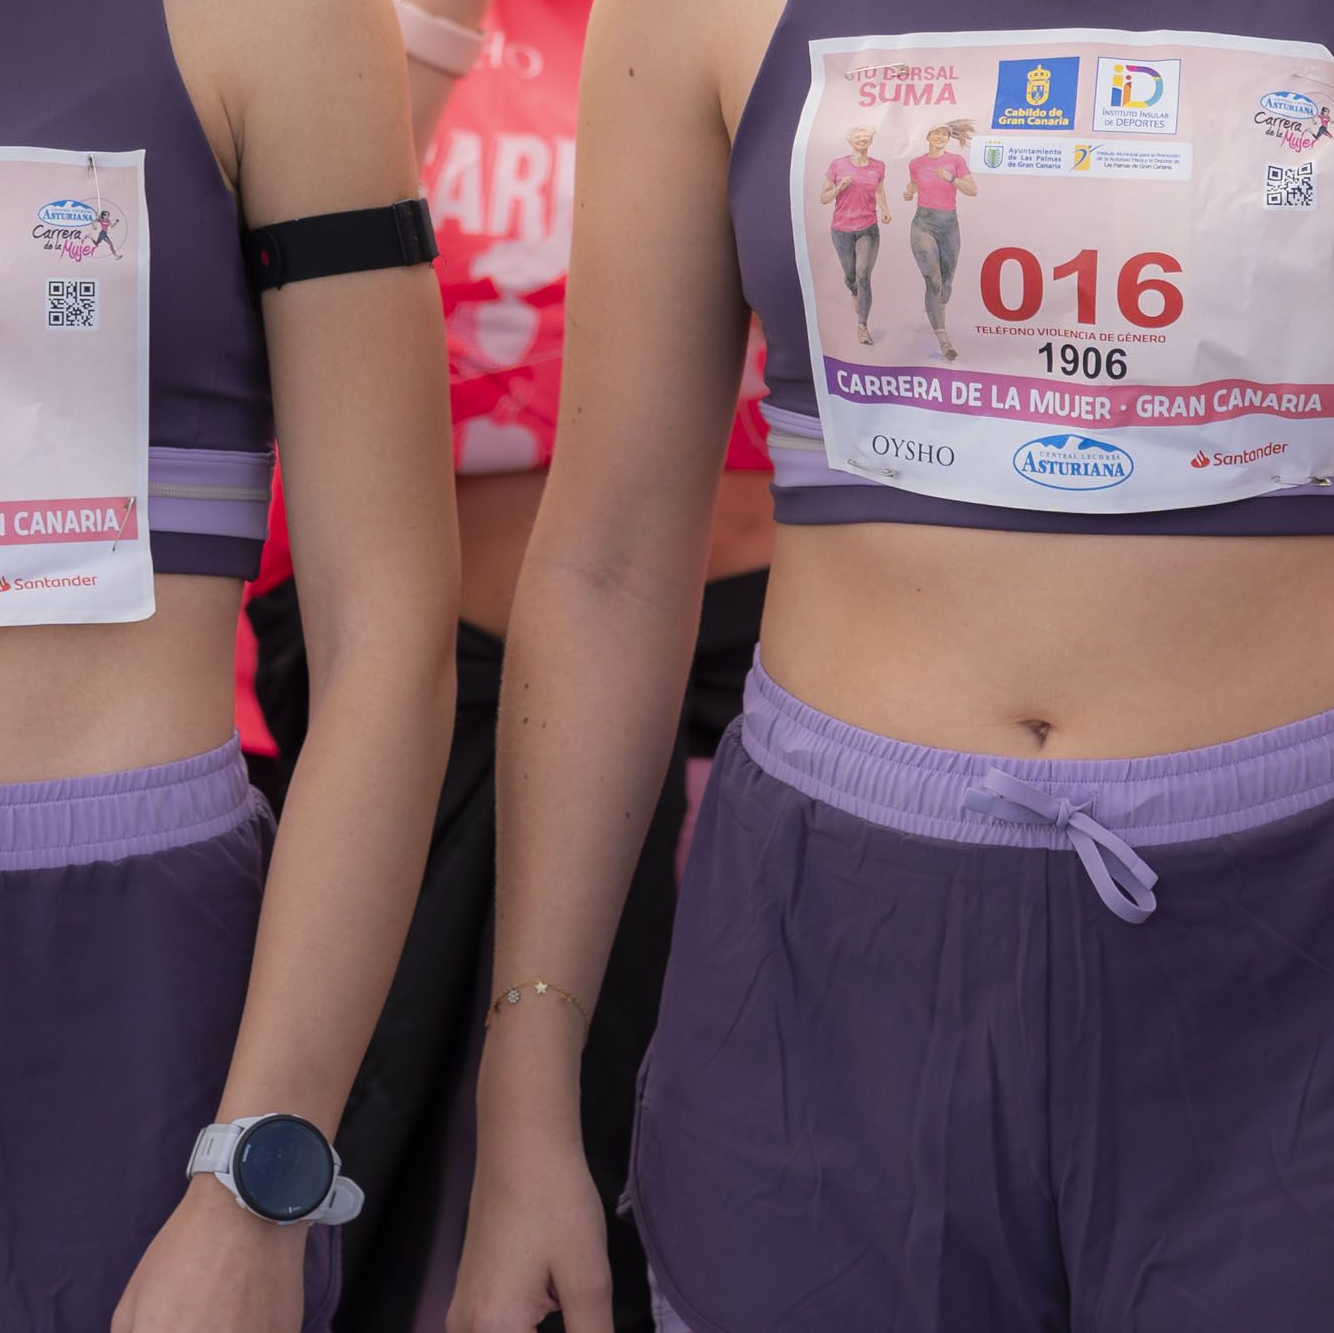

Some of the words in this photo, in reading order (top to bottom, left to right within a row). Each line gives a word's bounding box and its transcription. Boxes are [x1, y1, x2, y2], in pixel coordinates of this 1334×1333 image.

[882, 65, 960, 82] DORSAL
[858, 82, 957, 107] SUMA
[1004, 108, 1046, 117] Cabildo
[1047, 108, 1064, 117] de
[1265, 98, 1314, 116] ASTURIANA
[998, 117, 1026, 125] Gran
[1027, 117, 1070, 126] Canaria
[1117, 118, 1166, 129] DEPORTES
[1254, 112, 1303, 132] Carrera
[1281, 130, 1319, 153] Mujer
[1008, 148, 1063, 157] Ayuntamiento
[43, 210, 93, 222] ASTURIANA
[32, 225, 82, 241] Carrera
[60, 240, 98, 262] Mujer
[980, 247, 1184, 329] 016
[975, 325, 1035, 336] TELÉFONO
[1037, 328, 1097, 341] VIOLENCIA
[1099, 333, 1114, 342] DE
[1117, 332, 1167, 344] GÉNERO
[1038, 342, 1128, 380] 1906
[836, 370, 943, 402] CARRERA
[951, 381, 983, 407] DE
[991, 385, 1021, 411] LA
[1029, 389, 1112, 420] MUJER
[1136, 394, 1206, 419] GRAN
[1213, 387, 1323, 413] CANARIA
[872, 434, 956, 467] OYSHO
[1213, 442, 1290, 467] Santander
[1021, 451, 1126, 478] ASTURIANA
[14, 508, 120, 536] CANARIA
[14, 575, 98, 592] Santander
